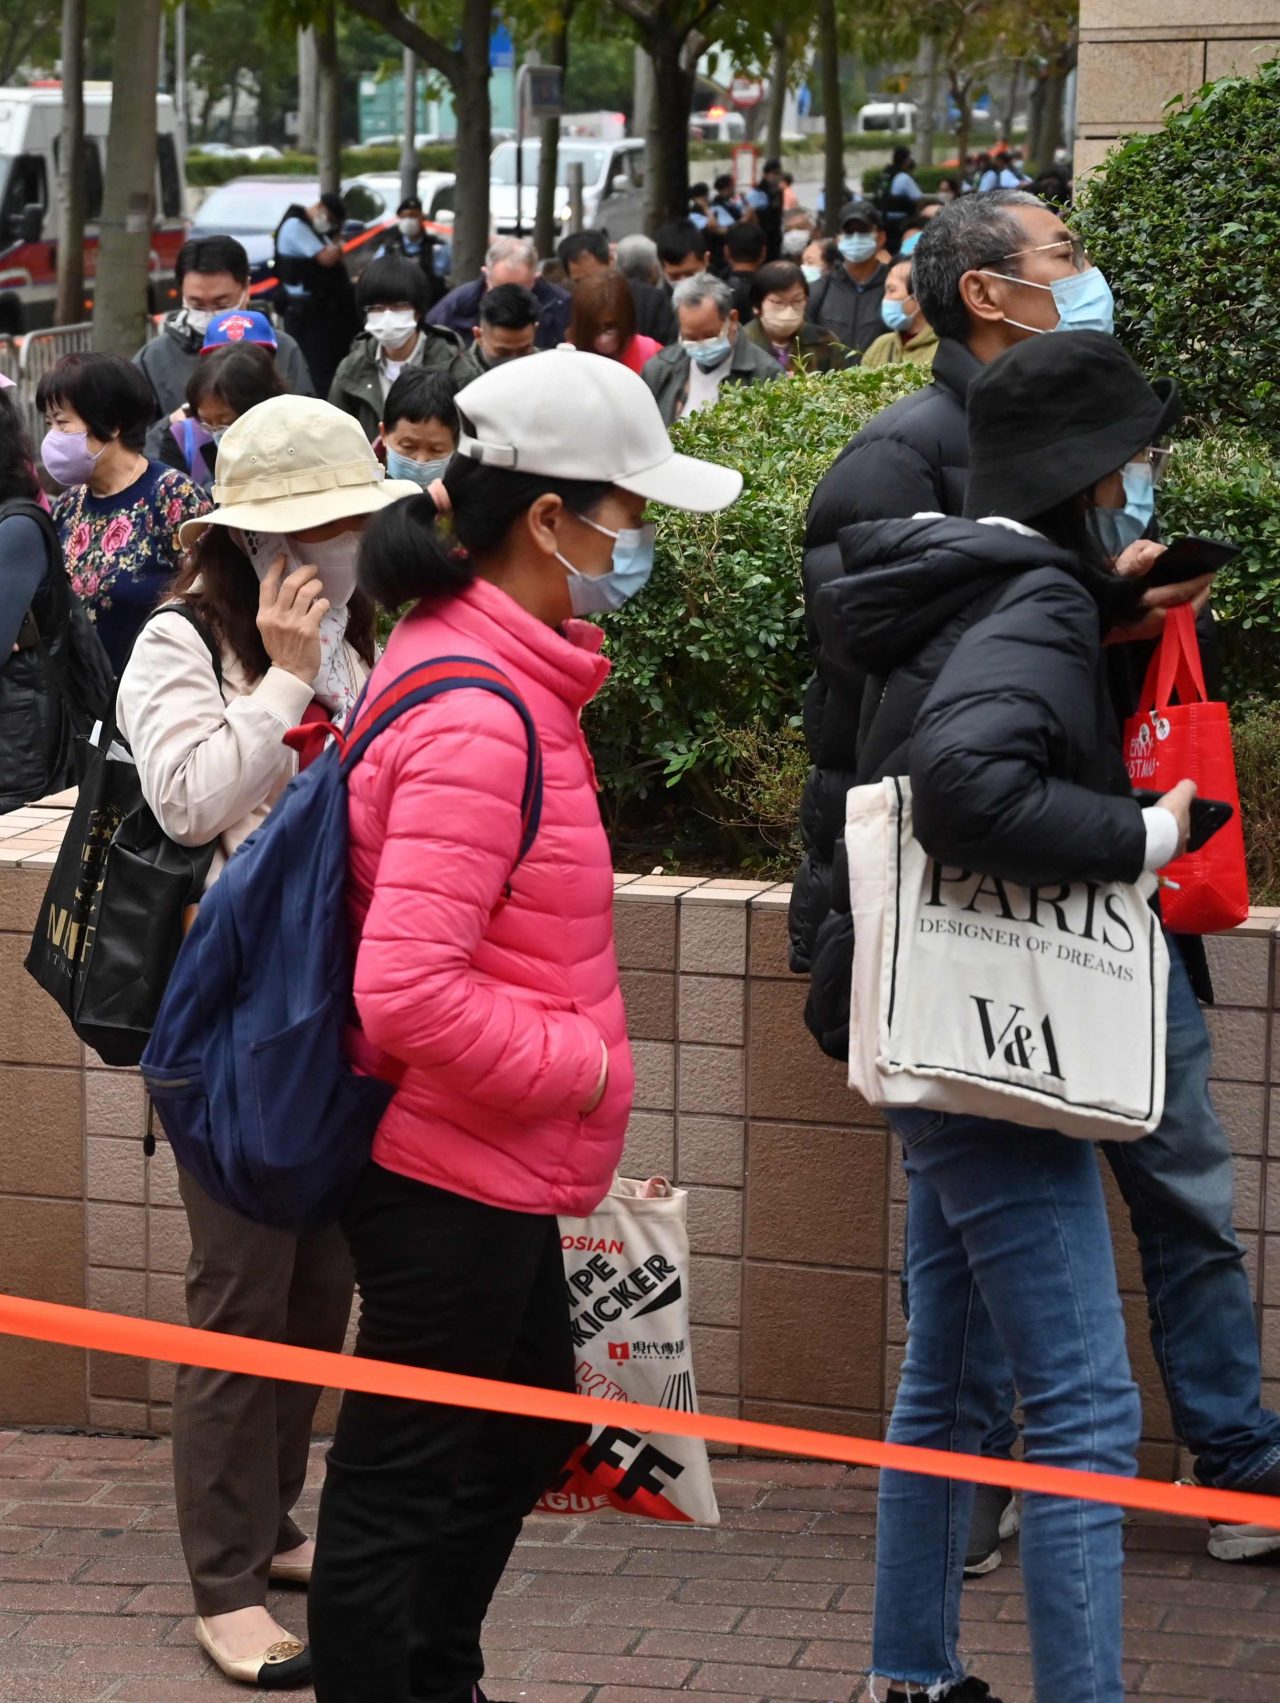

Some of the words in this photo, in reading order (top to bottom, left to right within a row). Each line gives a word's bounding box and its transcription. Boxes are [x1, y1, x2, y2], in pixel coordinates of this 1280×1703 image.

[919, 918, 1021, 949] DESIGNER
[1026, 935, 1052, 954] OF
[1056, 944, 1134, 983] DREAMS
[969, 995, 1066, 1081] V&A
